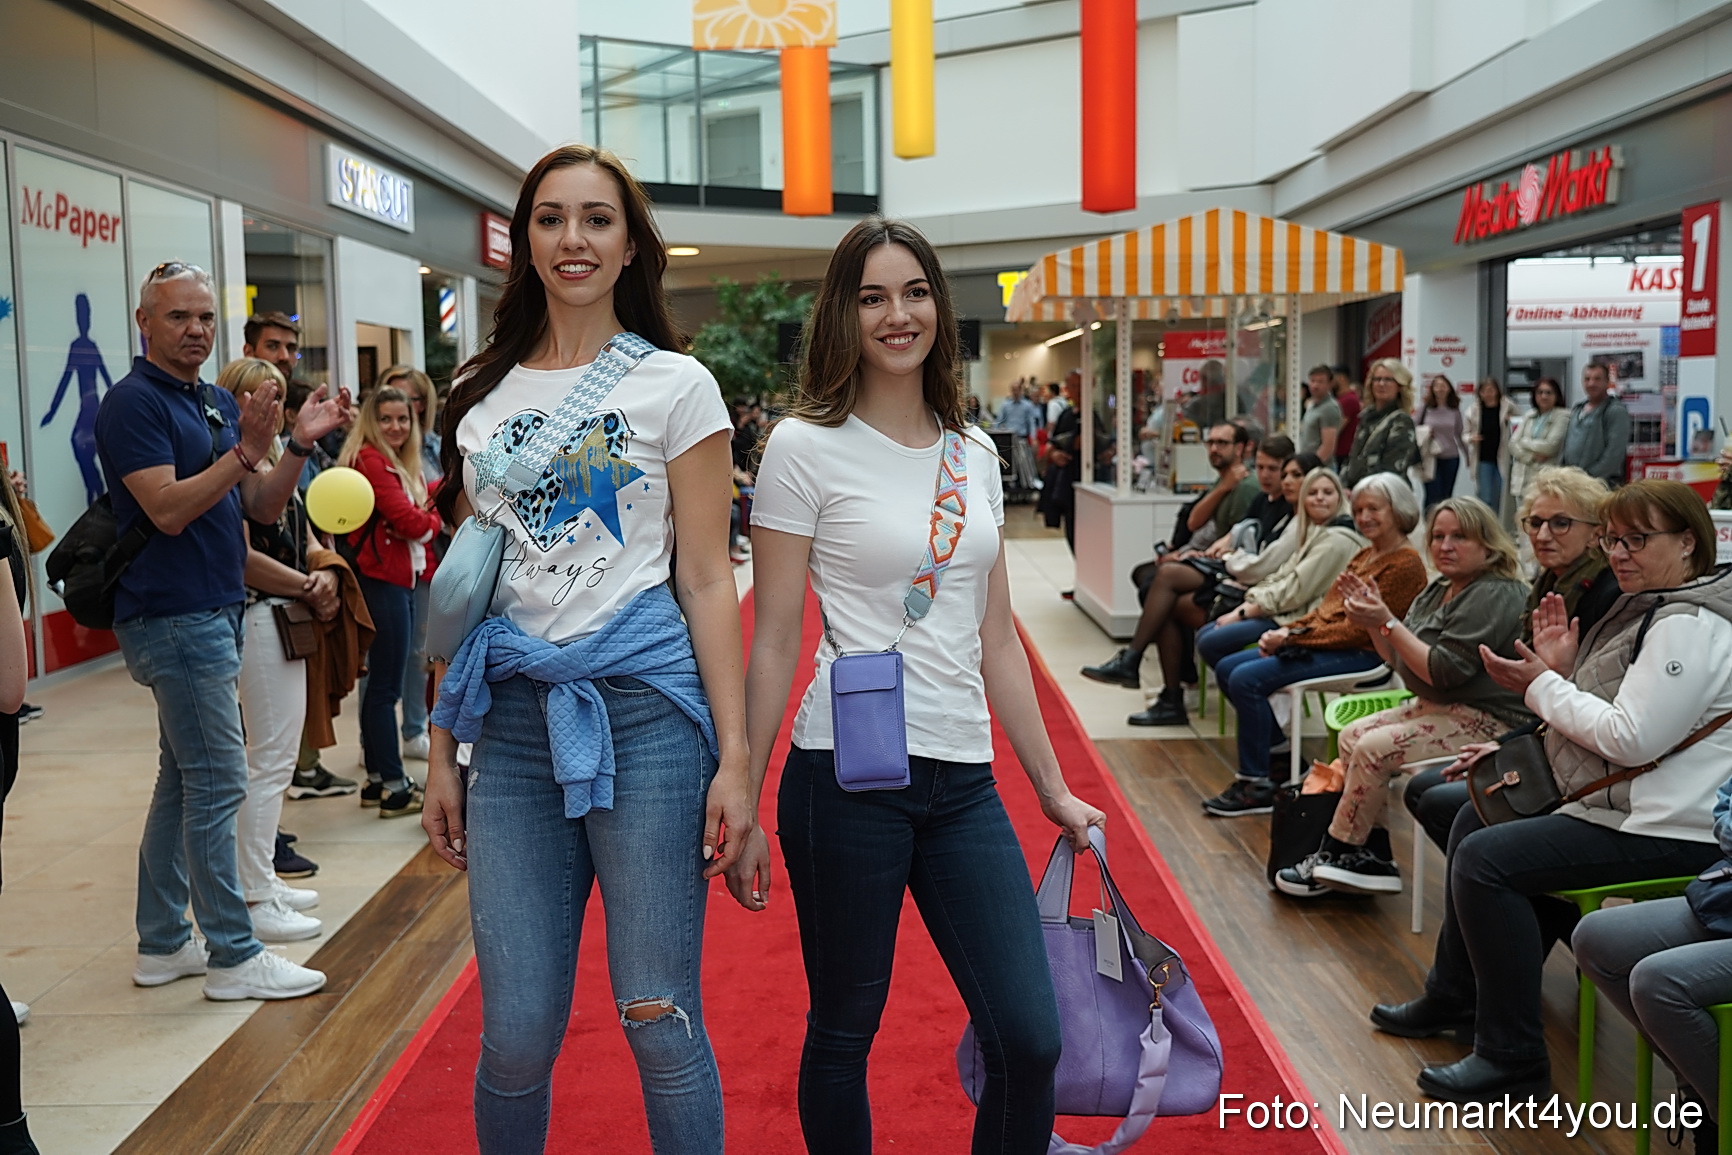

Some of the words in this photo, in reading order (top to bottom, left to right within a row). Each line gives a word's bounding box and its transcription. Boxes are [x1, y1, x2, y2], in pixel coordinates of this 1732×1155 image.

[21, 185, 121, 249] McPaper
[1691, 213, 1712, 291] 1
[1628, 267, 1684, 292] KAS
[497, 529, 615, 606] Always
